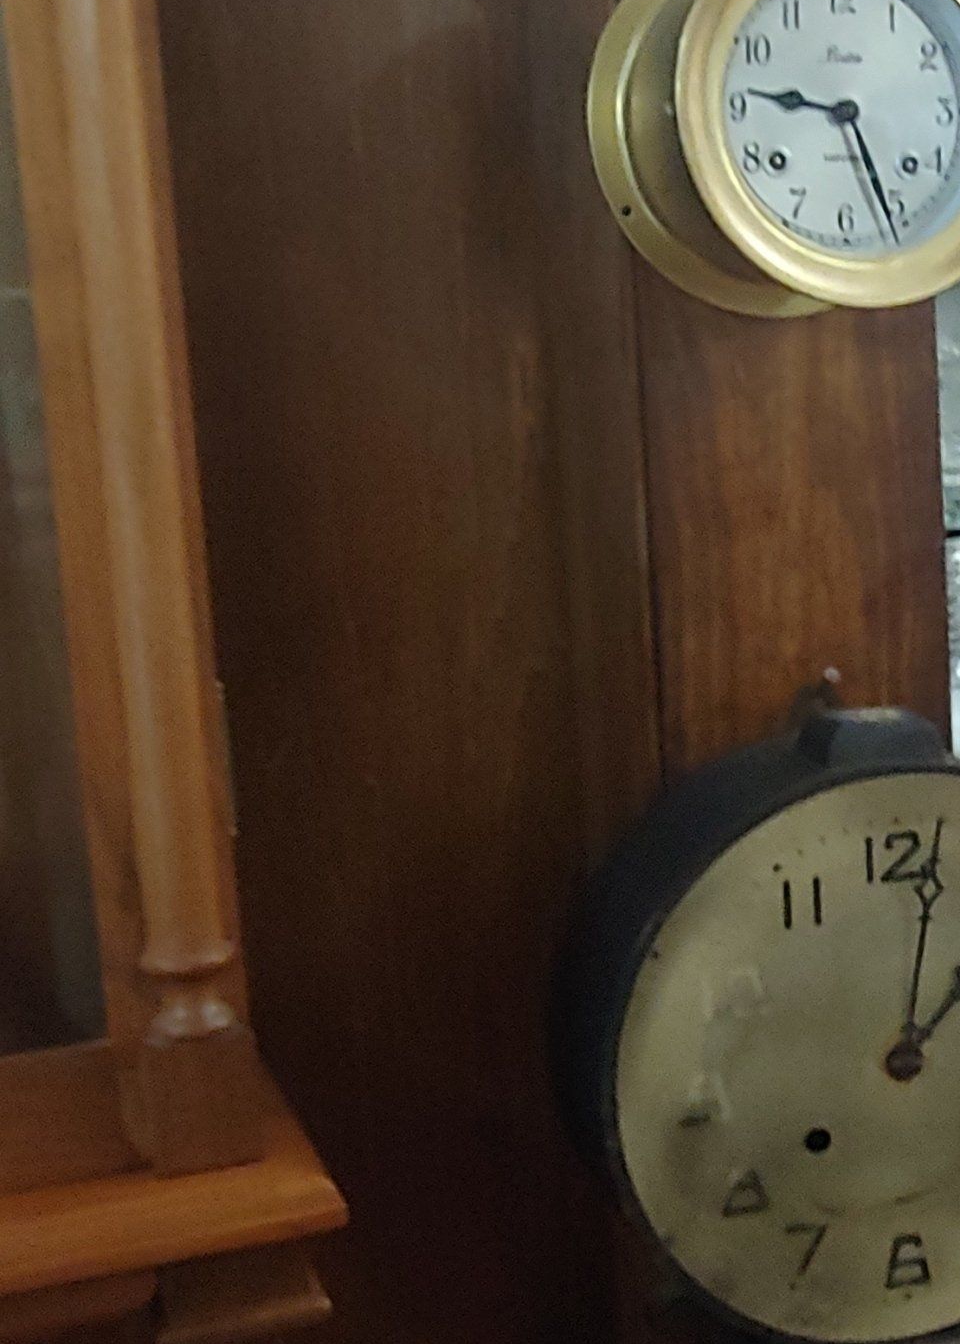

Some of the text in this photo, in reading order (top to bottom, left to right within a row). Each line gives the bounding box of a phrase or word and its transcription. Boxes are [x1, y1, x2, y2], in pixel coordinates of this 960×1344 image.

[888, 2, 897, 34] 1
[743, 36, 772, 67] 10
[918, 40, 939, 73] 2
[729, 92, 747, 123] 9
[935, 96, 955, 127] 3
[742, 141, 762, 175] 8
[925, 145, 944, 175] 4
[788, 186, 808, 220] 7
[837, 202, 856, 234] 6
[887, 188, 906, 221] 5
[864, 829, 923, 885] 12
[782, 876, 823, 930] 11
[784, 1220, 828, 1276] 7
[883, 1232, 932, 1291] 6
